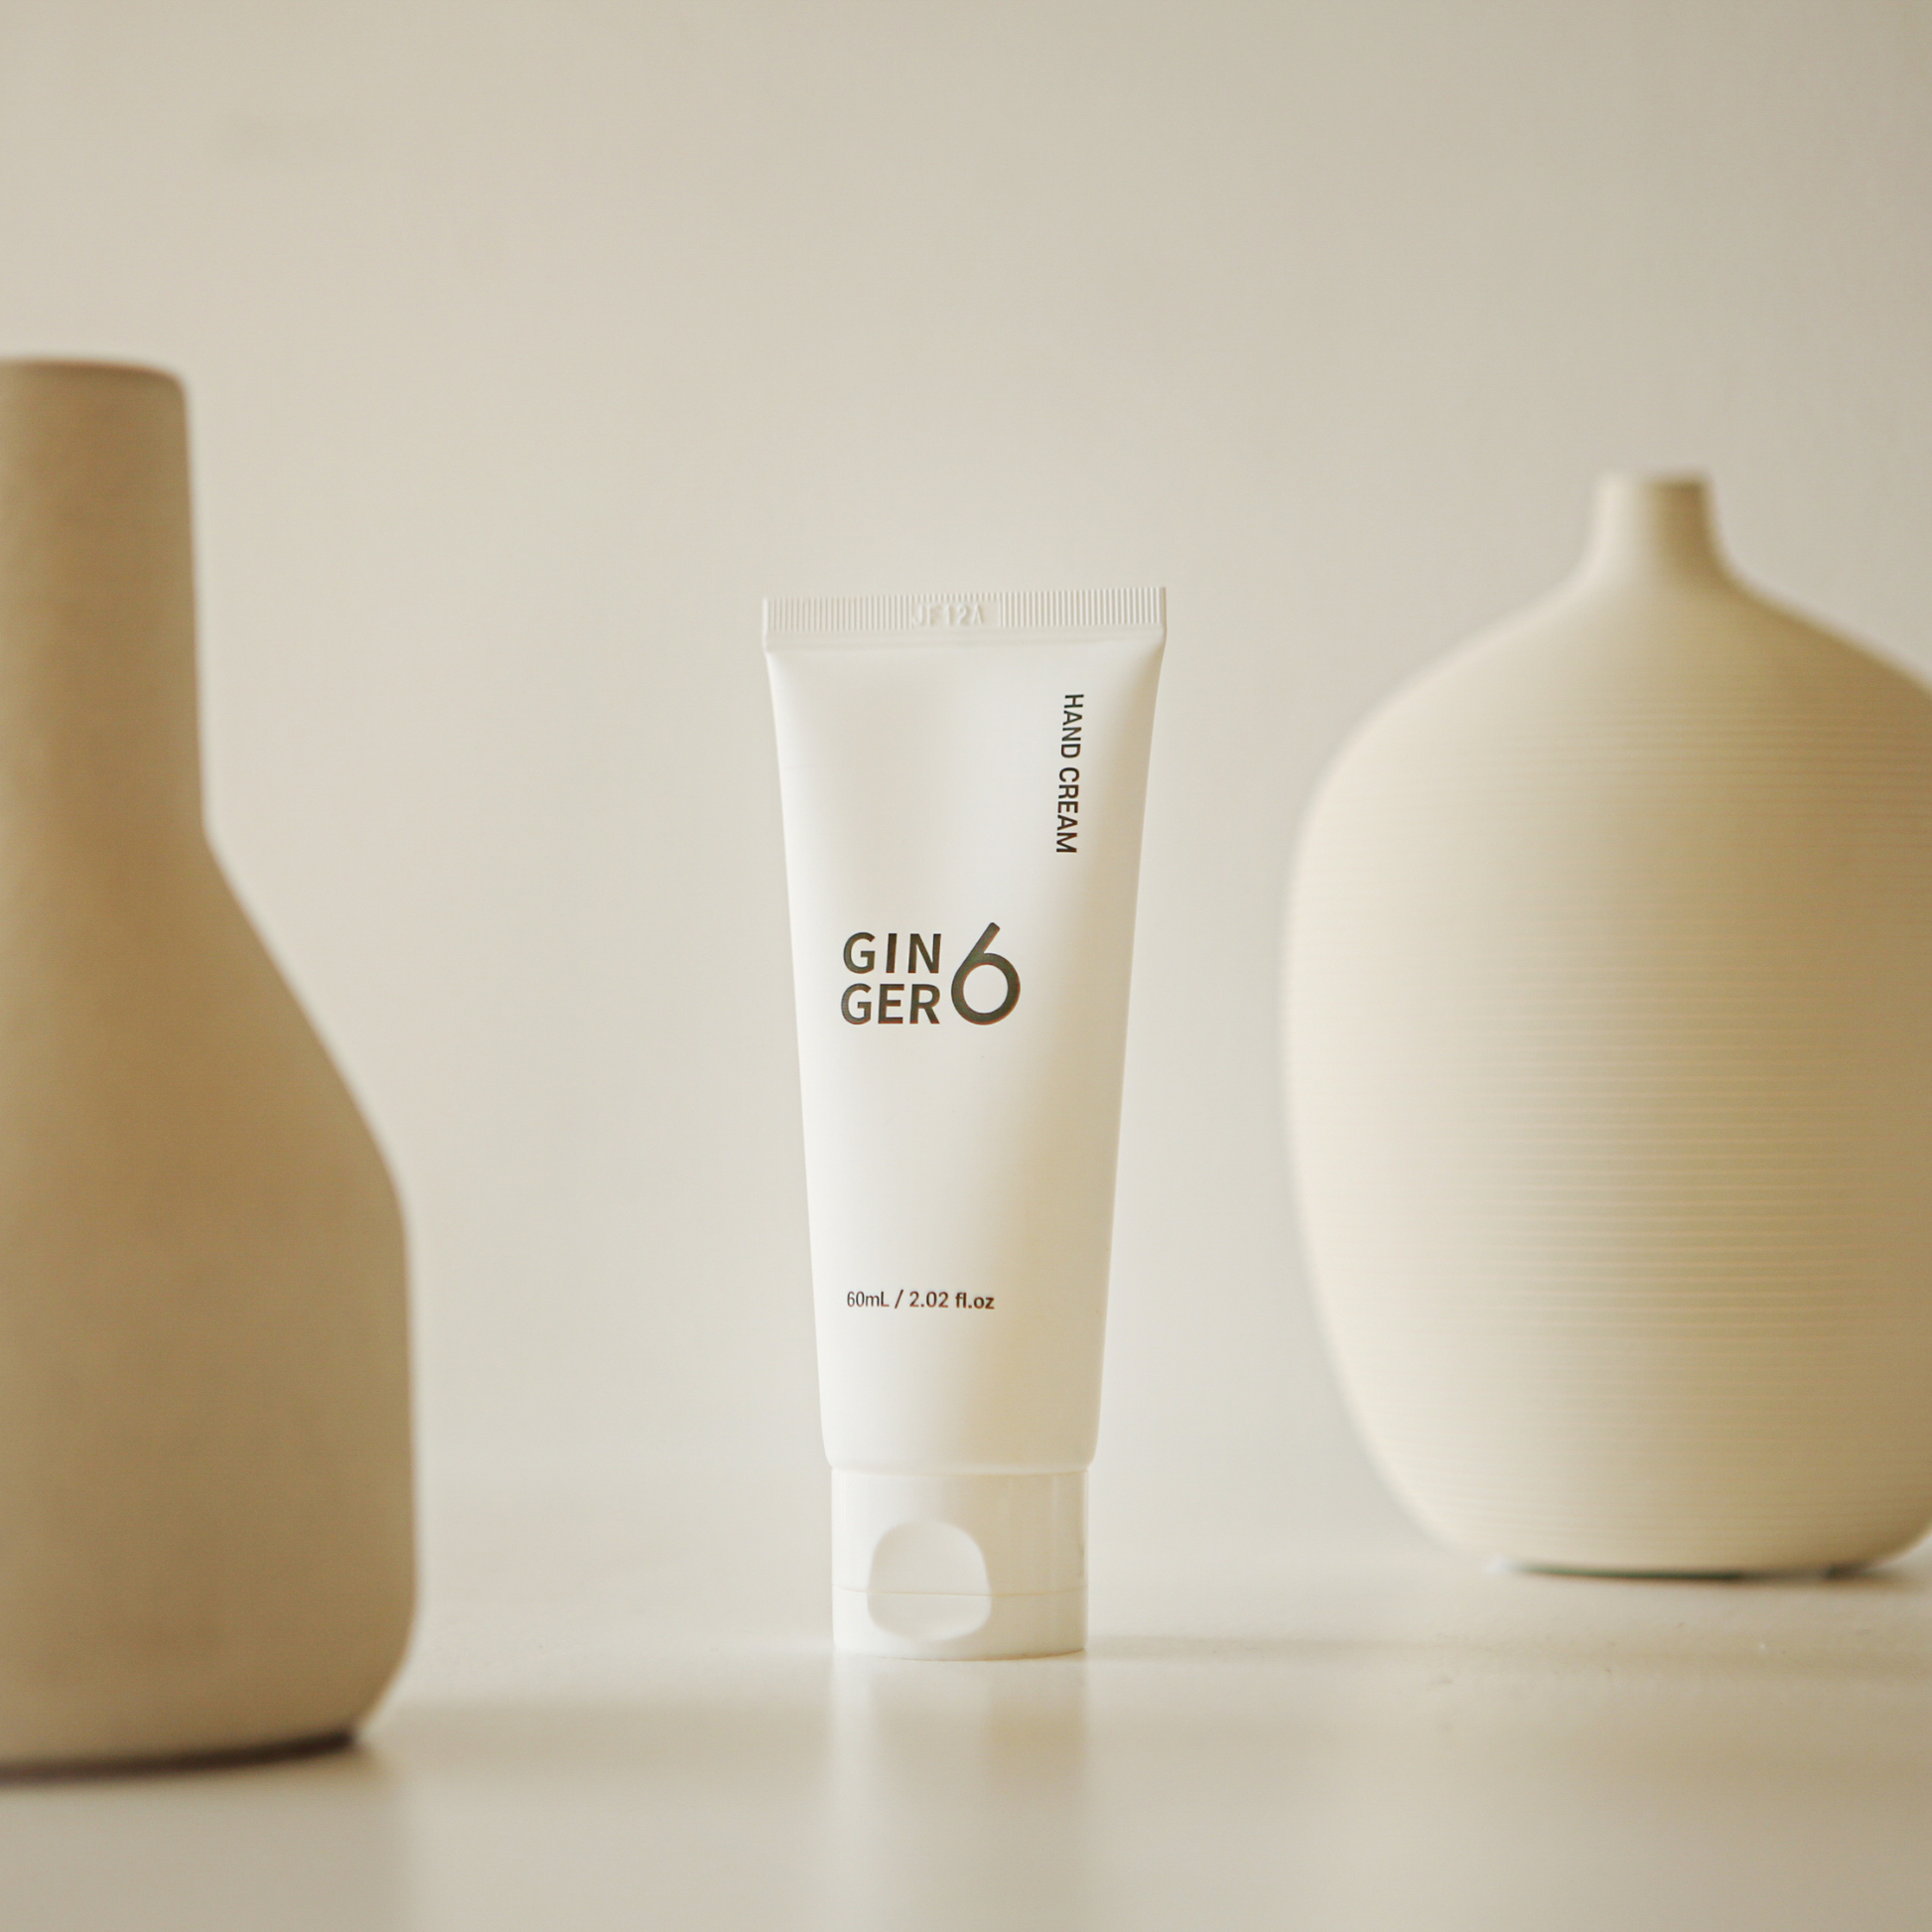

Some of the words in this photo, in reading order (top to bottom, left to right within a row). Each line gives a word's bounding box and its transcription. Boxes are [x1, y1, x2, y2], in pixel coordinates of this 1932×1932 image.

[1061, 693, 1084, 759] HAND
[1055, 766, 1080, 854] CREAM
[843, 931, 942, 974] GIN
[950, 921, 1021, 1026] 6
[840, 982, 941, 1026] GER
[846, 1291, 890, 1308] 60mL
[894, 1289, 904, 1310] /
[908, 1291, 949, 1309] 2.02
[955, 1292, 995, 1310] fl.oz
